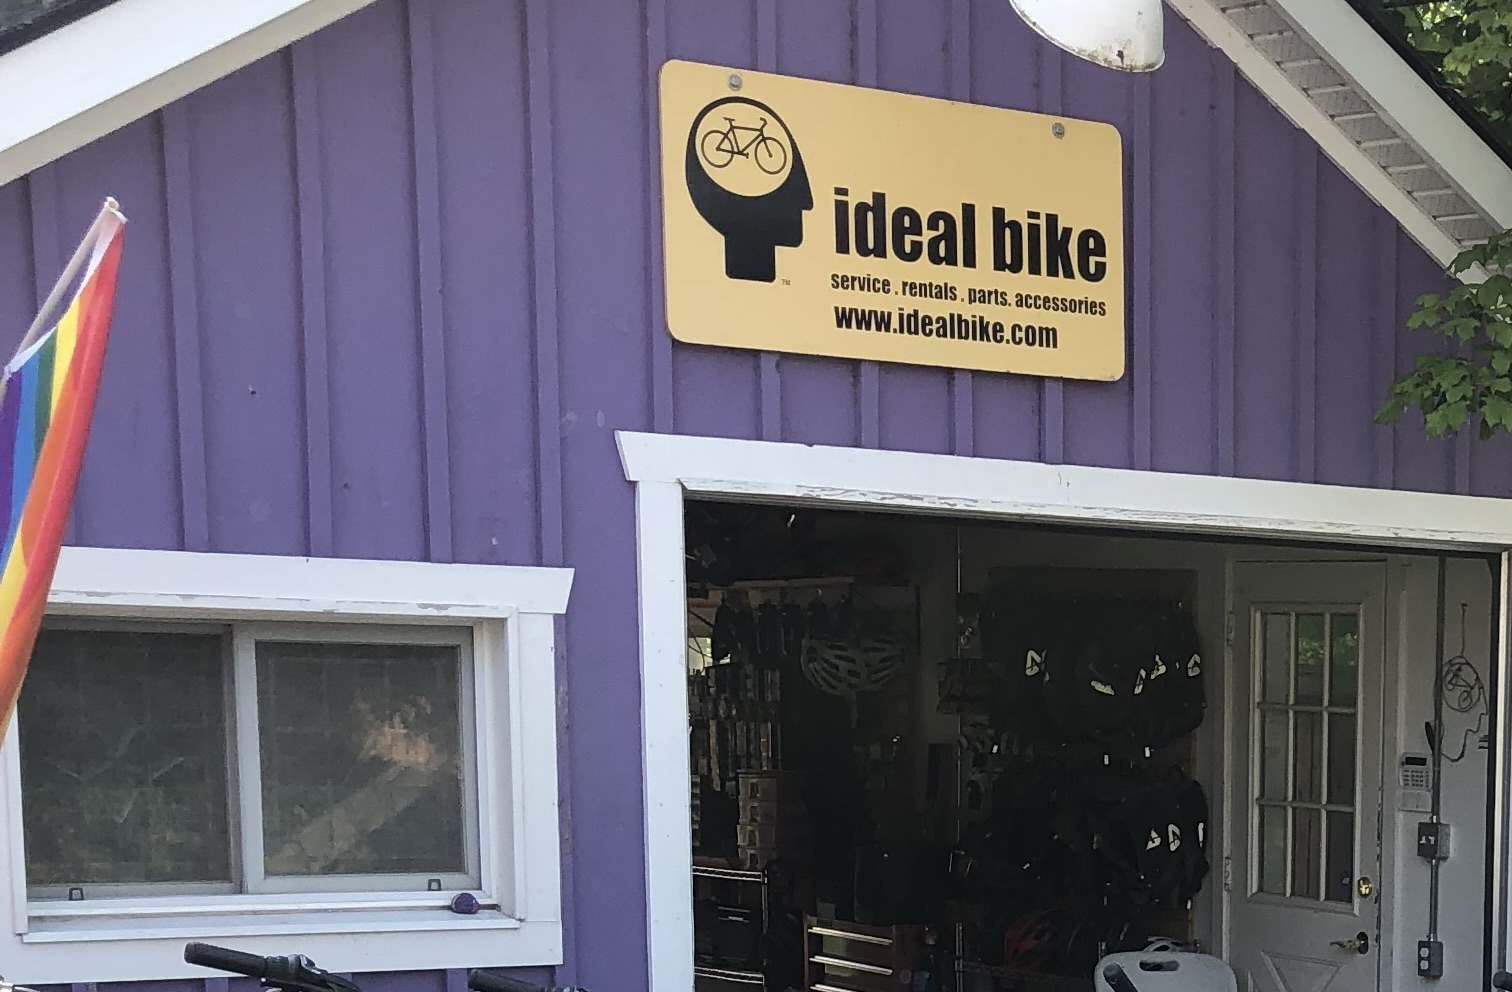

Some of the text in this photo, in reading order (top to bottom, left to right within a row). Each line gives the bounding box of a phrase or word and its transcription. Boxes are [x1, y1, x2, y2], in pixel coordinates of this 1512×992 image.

[834, 187, 1108, 283] ideal bike
[830, 272, 891, 296] service
[901, 280, 958, 302] rentals
[1015, 291, 1108, 318] accessories
[833, 305, 1059, 350] www.idealbike.com
